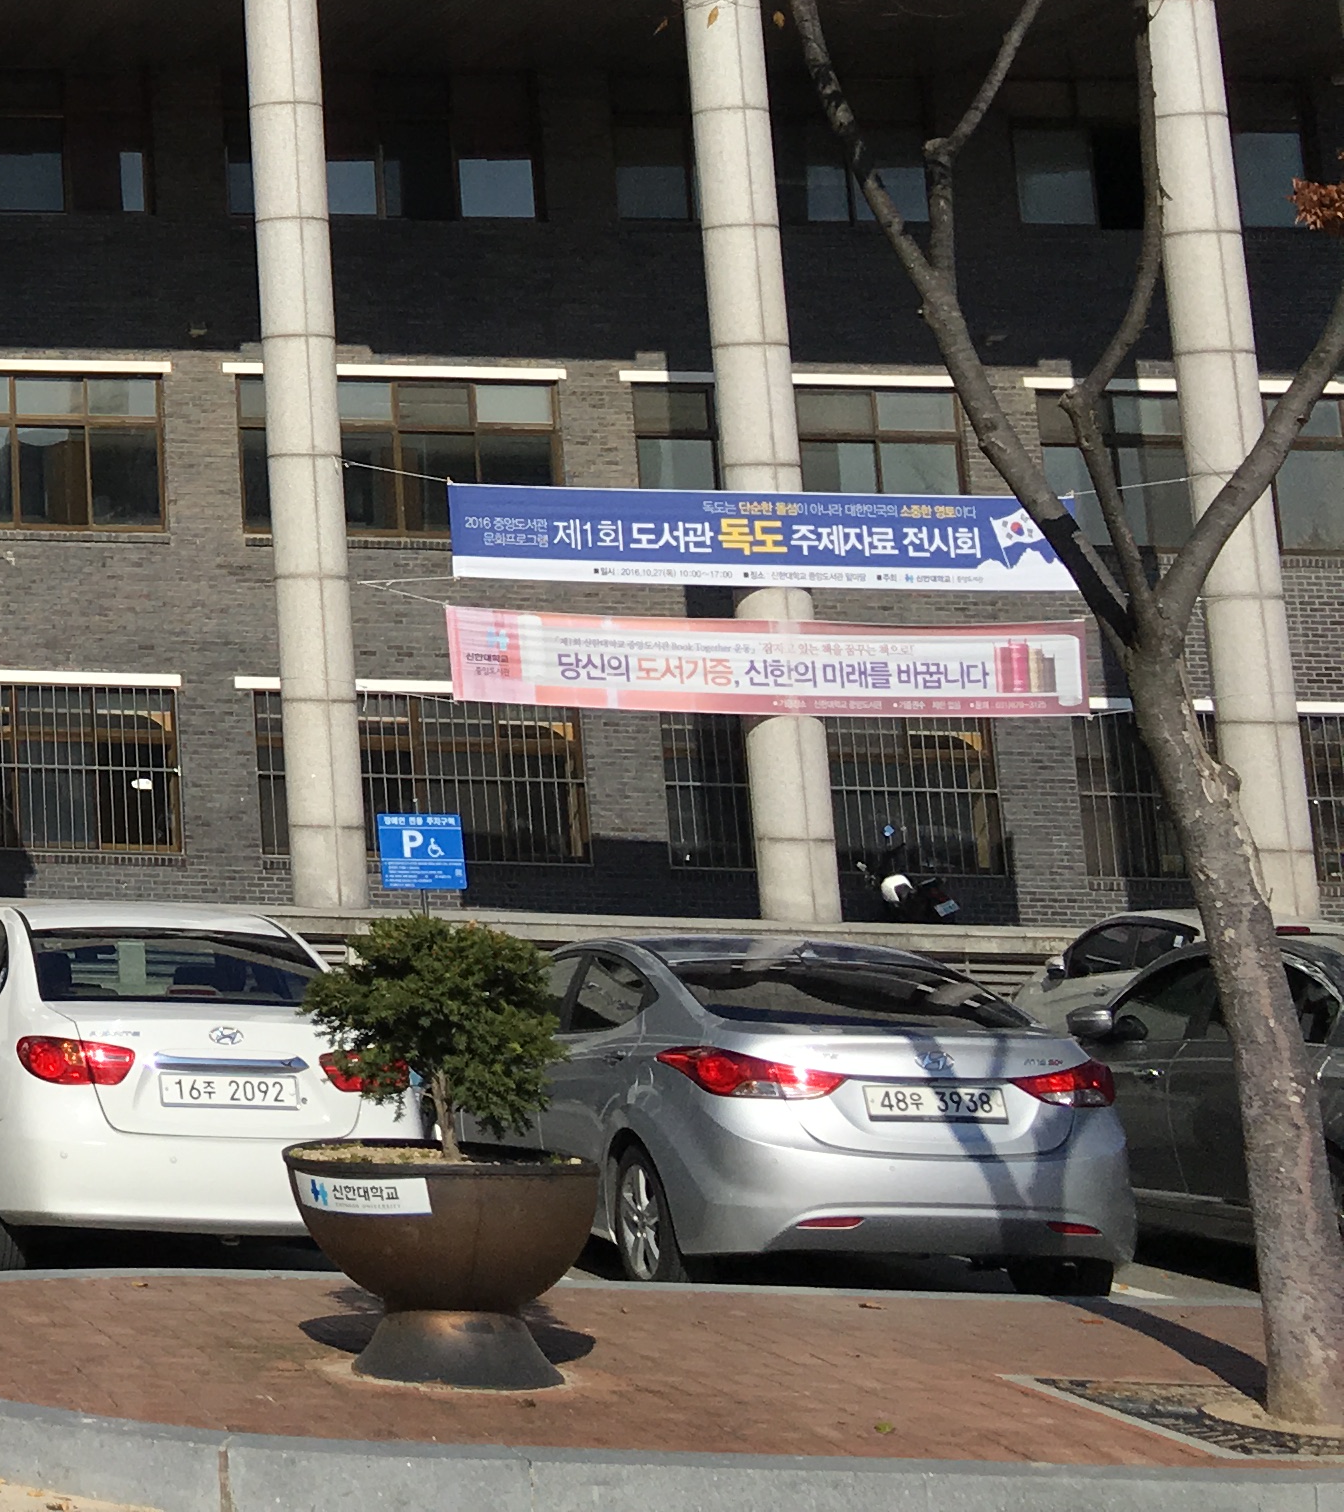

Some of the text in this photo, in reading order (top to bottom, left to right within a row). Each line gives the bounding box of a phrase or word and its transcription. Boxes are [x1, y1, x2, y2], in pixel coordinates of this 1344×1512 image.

[702, 500, 736, 515] 독도는
[739, 501, 773, 516] 단순한
[810, 502, 842, 516] 아니라
[845, 503, 898, 517] 대한민국의
[900, 504, 932, 519] 소중한
[934, 505, 977, 519] 영토이다
[465, 516, 548, 532] 2016 중앙도서관
[483, 532, 549, 548] 문화프로그램
[553, 518, 981, 559] 제1회 도서관 독도 주제자료 전시회
[466, 653, 509, 663] 신한대학교
[671, 641, 692, 651] Book
[695, 643, 731, 653] Together
[798, 642, 819, 656] 있는
[557, 652, 989, 689] 당신의 도서기증, 신한의 미래를 바꿉니다
[402, 830, 424, 858] P
[174, 1080, 285, 1103] 16주 2092
[880, 1089, 993, 1114] 48우 3938
[332, 1185, 399, 1201] 신한대학교
